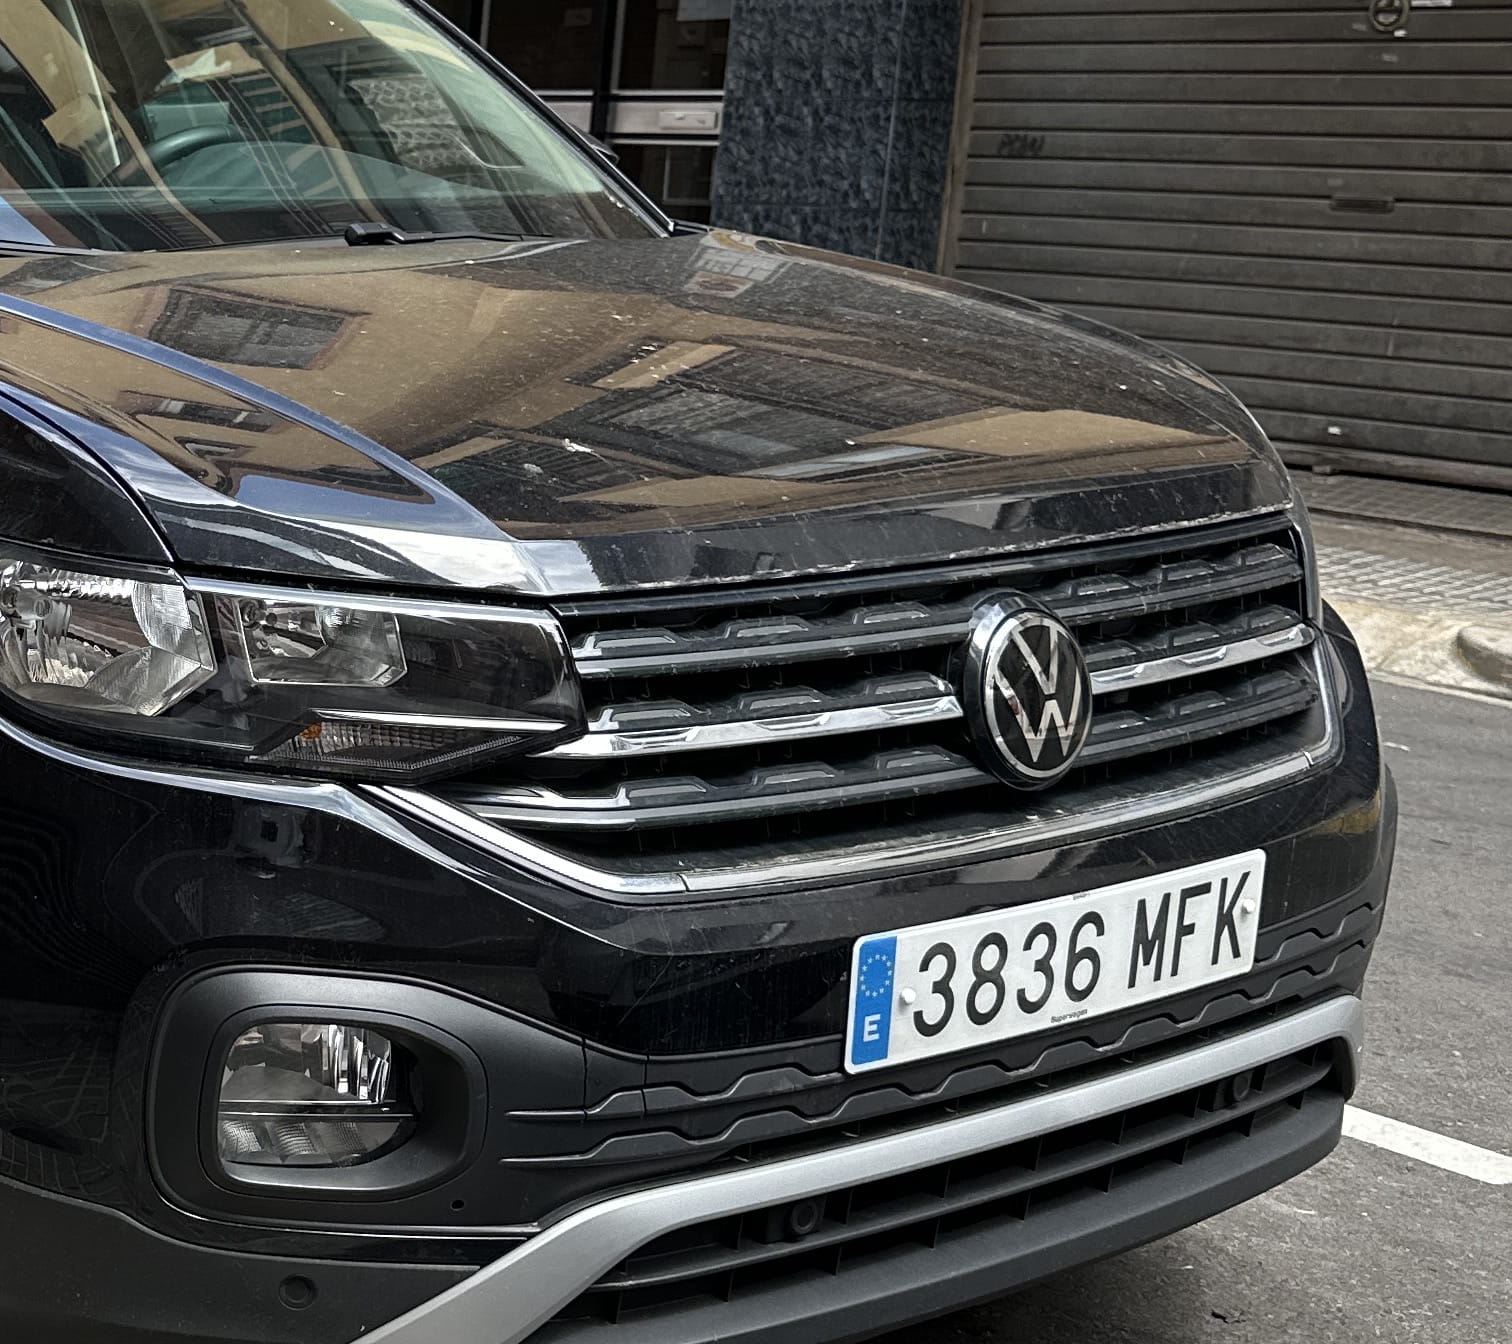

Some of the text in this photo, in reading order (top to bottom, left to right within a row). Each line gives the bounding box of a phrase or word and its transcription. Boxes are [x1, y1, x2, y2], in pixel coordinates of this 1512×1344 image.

[912, 870, 1252, 1038] 3836 MFK
[863, 1014, 880, 1042] E
